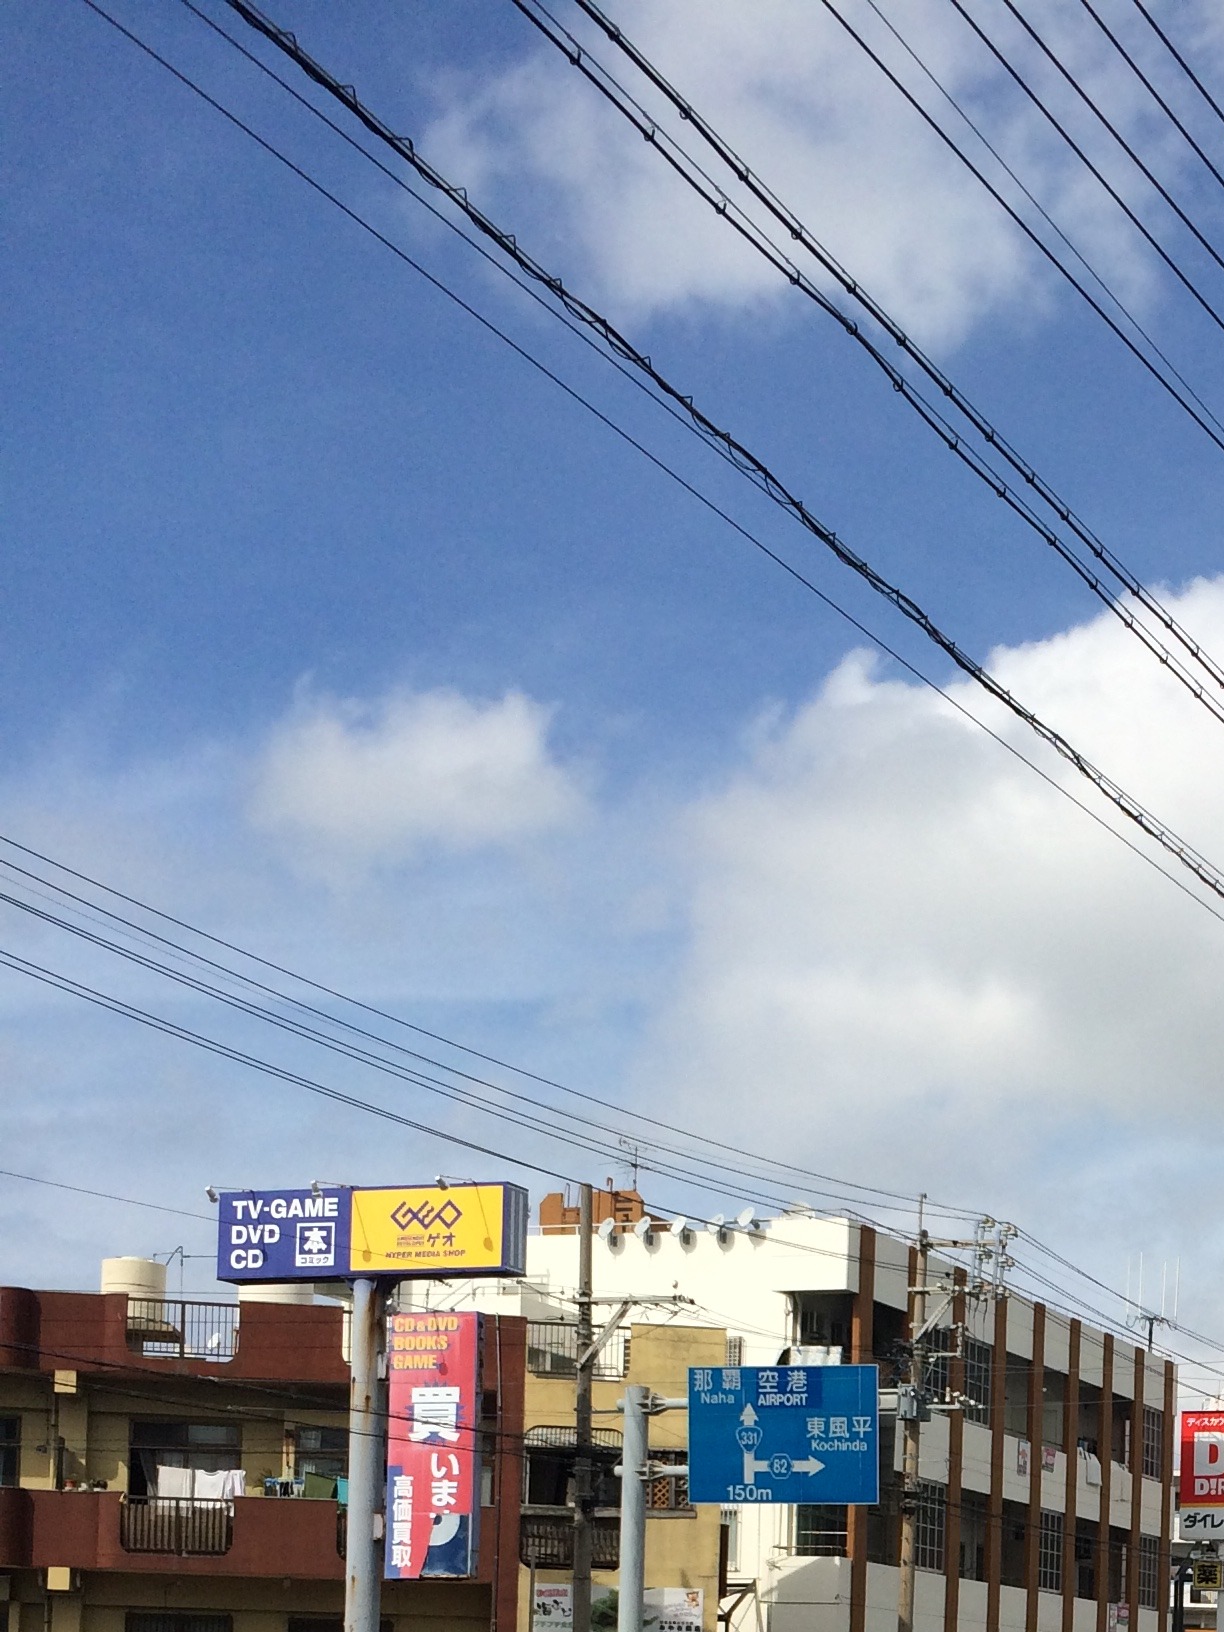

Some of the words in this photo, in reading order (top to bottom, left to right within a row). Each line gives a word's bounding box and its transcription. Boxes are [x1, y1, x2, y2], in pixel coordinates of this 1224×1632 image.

[232, 1198, 339, 1220] TV-GAME
[390, 1199, 463, 1231] GEO
[231, 1225, 280, 1245] DVD
[303, 1228, 328, 1254] 本
[427, 1232, 456, 1248] ゲオ
[230, 1249, 264, 1270] CD
[300, 1256, 330, 1265] コミック
[385, 1251, 413, 1259] HYPER
[443, 1249, 466, 1257] SHOP
[393, 1336, 448, 1351] BOOKS
[393, 1355, 437, 1370] GAME
[694, 1369, 741, 1392] 那覇
[758, 1370, 808, 1393] 空港
[701, 1393, 735, 1404] Naha
[758, 1393, 808, 1407] AIRPORT
[806, 1416, 873, 1439] 東風平
[741, 1432, 758, 1445] 331
[811, 1439, 868, 1451] Kochinda
[409, 1387, 461, 1518] 買いま
[773, 1459, 788, 1474] 82
[727, 1485, 772, 1501] 150m
[391, 1475, 414, 1569] 高価買取
[1197, 1564, 1218, 1585] 薬
